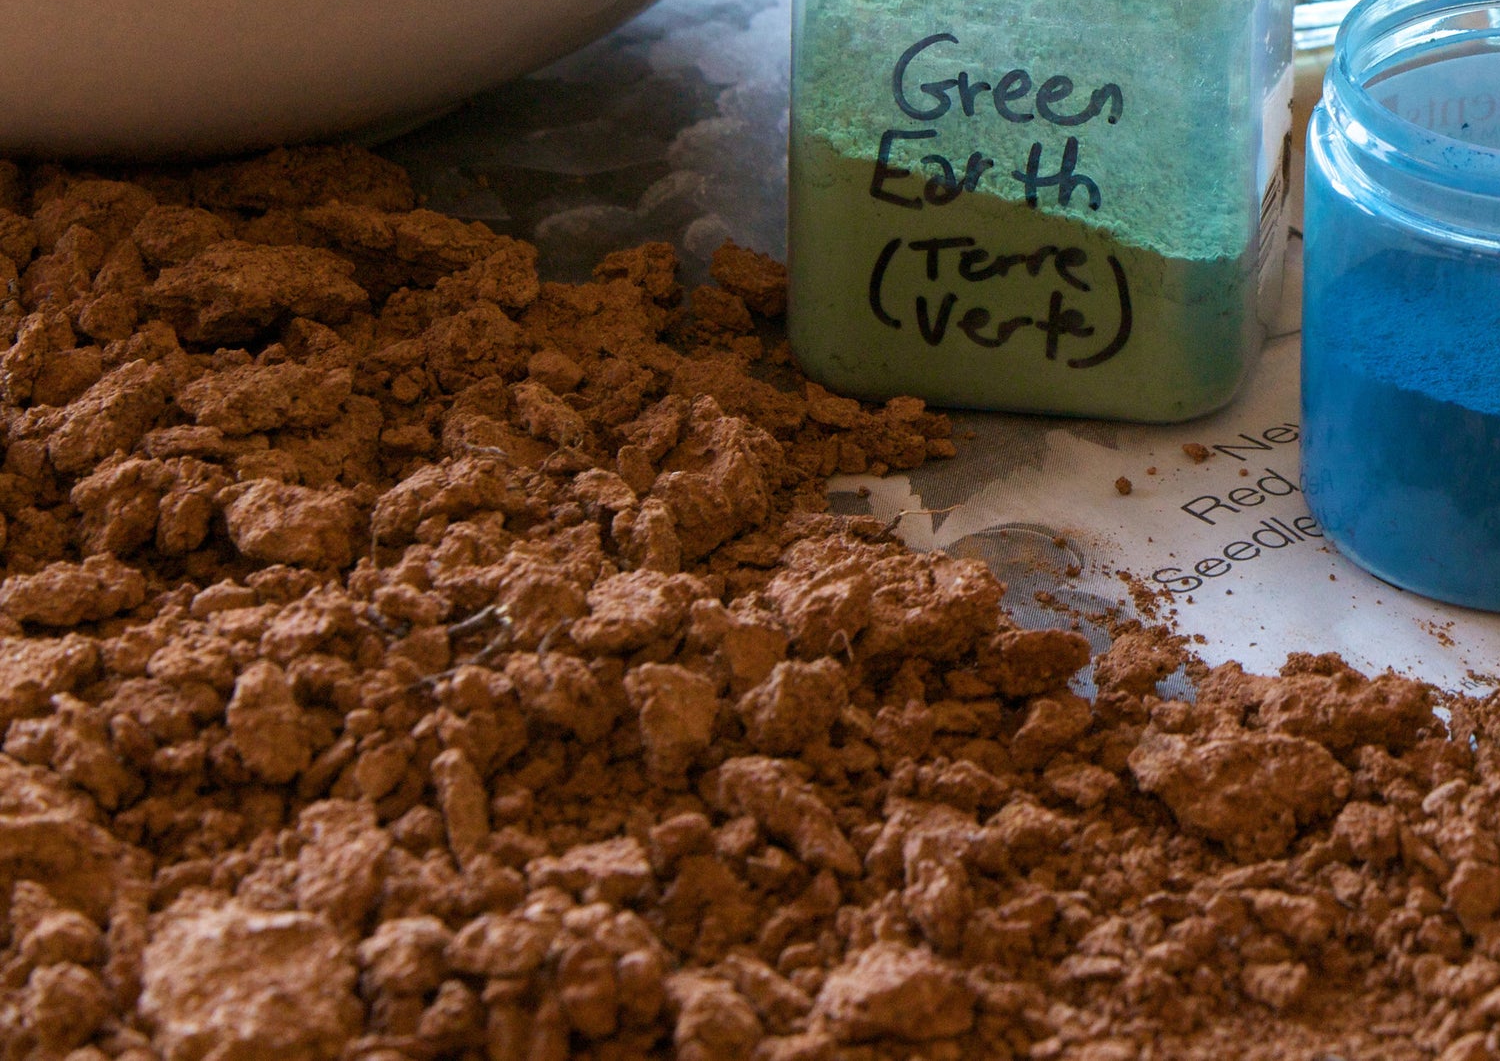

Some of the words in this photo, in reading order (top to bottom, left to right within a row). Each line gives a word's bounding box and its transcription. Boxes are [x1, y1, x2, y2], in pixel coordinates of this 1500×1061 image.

[892, 33, 1124, 126] Green
[869, 129, 1101, 211] Earth
[1212, 422, 1300, 462] Ne
[1180, 467, 1300, 526] Red
